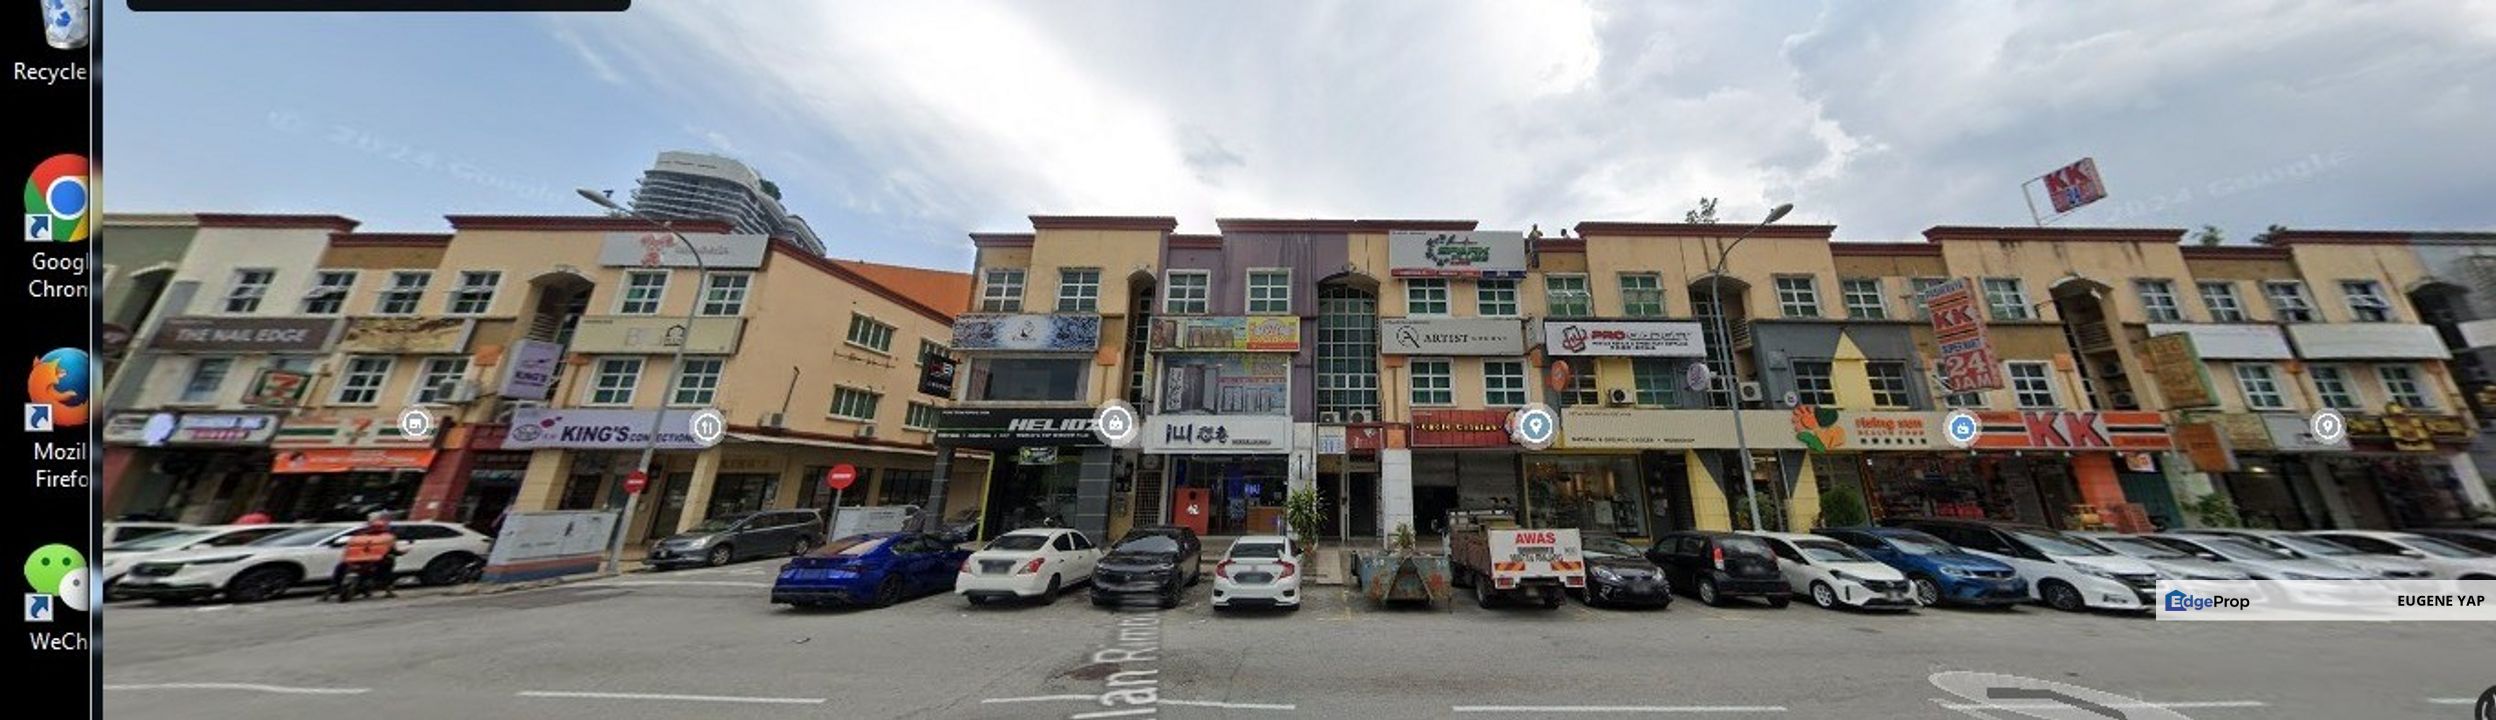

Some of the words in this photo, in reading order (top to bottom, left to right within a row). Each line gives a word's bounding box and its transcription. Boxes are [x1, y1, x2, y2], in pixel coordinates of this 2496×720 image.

[14, 62, 87, 85] Recycle
[32, 252, 89, 275] Googl
[1934, 305, 1975, 329] KK
[176, 328, 211, 342] THE
[214, 328, 252, 342] NAIL
[256, 328, 310, 342] EDGE
[1423, 334, 1468, 343] ARTIST
[1591, 330, 1626, 340] PRO
[1948, 351, 1987, 376] 24
[1954, 374, 1992, 391] JAM
[561, 425, 630, 443] KING'S
[2022, 411, 2111, 447] KK
[34, 442, 86, 460] Mozil
[1515, 532, 1556, 544] AWAS
[29, 632, 88, 650] WeCh
